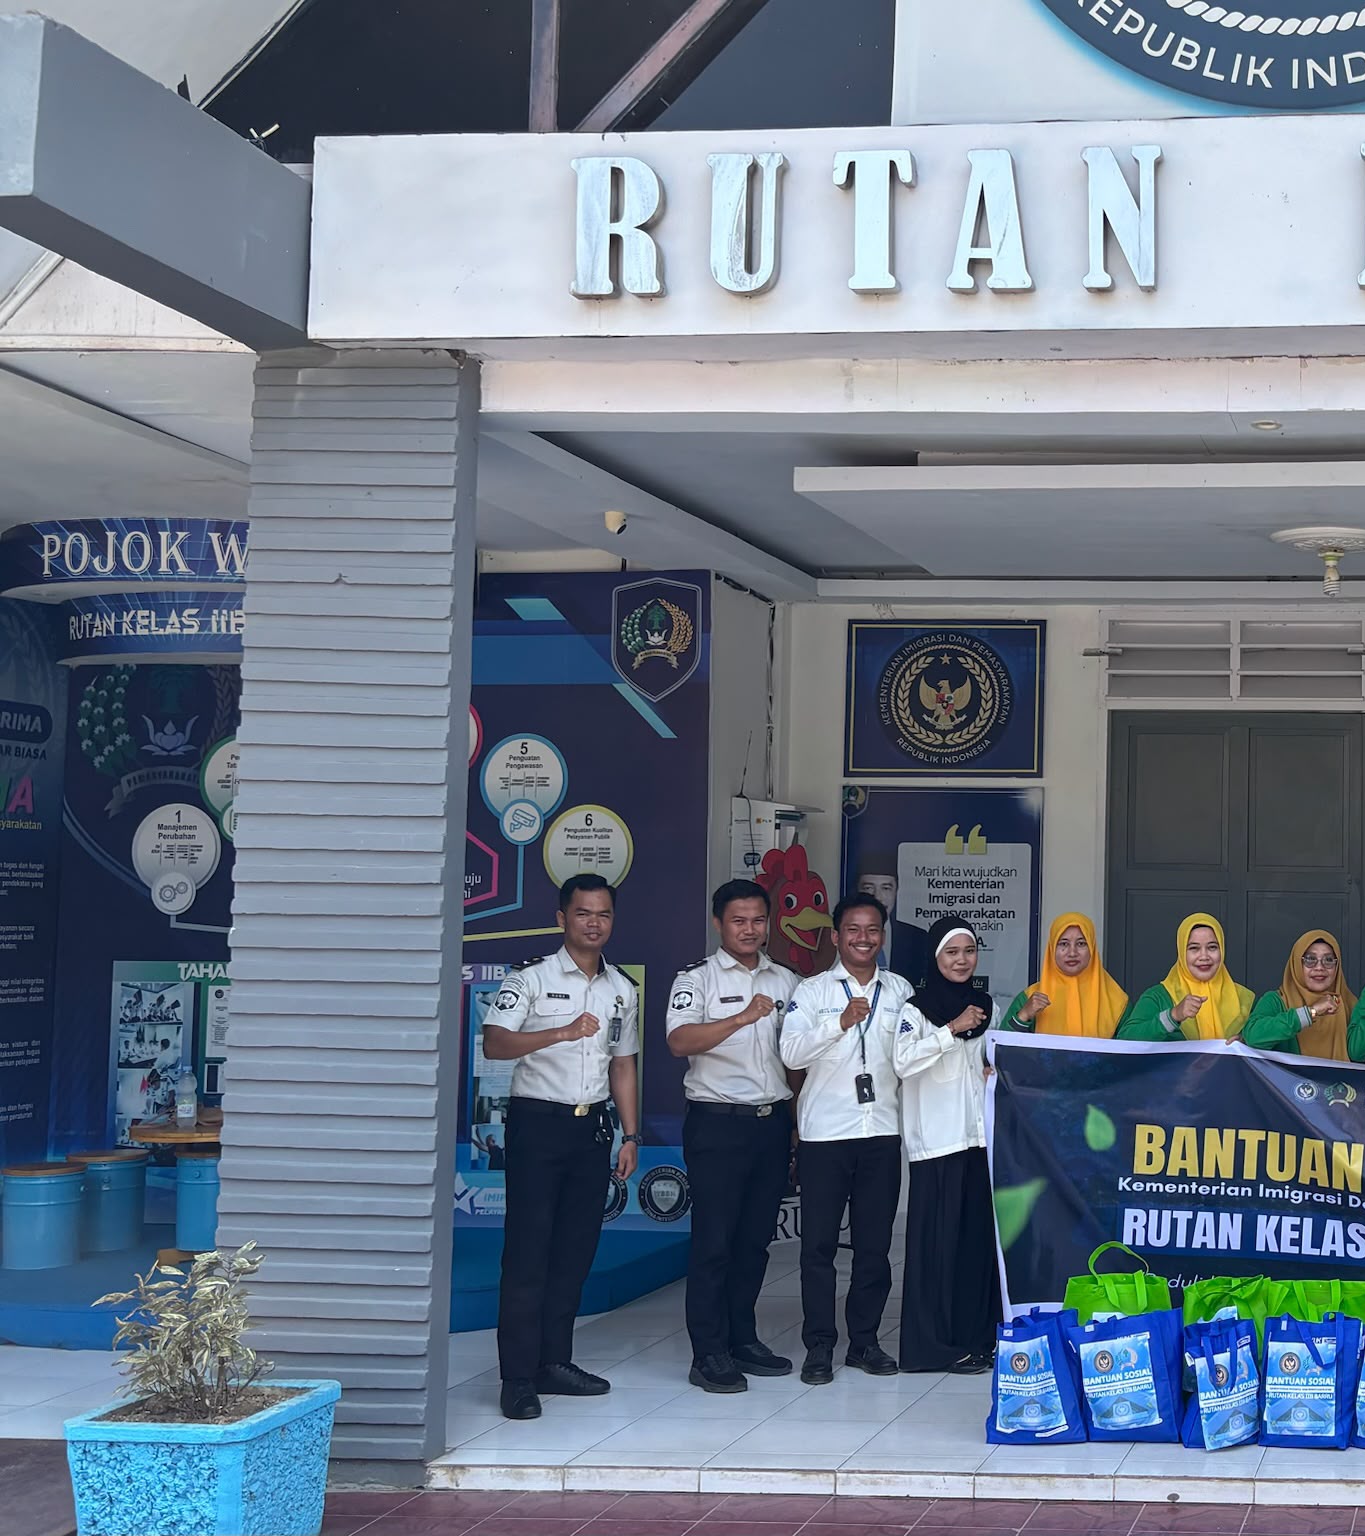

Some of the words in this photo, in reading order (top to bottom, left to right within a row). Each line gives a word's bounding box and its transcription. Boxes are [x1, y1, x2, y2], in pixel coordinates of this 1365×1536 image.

[569, 146, 1165, 300] RUTAN
[41, 531, 195, 578] POJOK
[69, 612, 115, 640] RUTAN
[122, 608, 200, 637] KELAS
[880, 654, 904, 725] KEMENTERIAN
[903, 634, 946, 657] IMIGRASI
[949, 634, 971, 646] DAN
[972, 641, 1011, 725] PEMASYARAKATAN
[14, 746, 47, 760] BIASA
[520, 742, 528, 755] 5
[896, 737, 938, 763] REPUBLIK
[942, 739, 991, 764] INDONESIA
[508, 754, 541, 762] Penguatan
[175, 810, 181, 823] 1
[585, 813, 593, 826] 6
[158, 823, 197, 832] Manajemen
[915, 866, 939, 877] Mari
[942, 866, 961, 877] kita
[963, 866, 1017, 879] wujudkan
[927, 878, 1005, 889] Kementerian
[928, 893, 975, 906] Imigrasi
[978, 893, 1000, 904] dan
[915, 908, 1015, 919] Pemasyarakatan
[482, 966, 506, 981] IIB
[1133, 1124, 1364, 1193] BANTUAN
[1118, 1177, 1252, 1196] Kementerian
[1259, 1184, 1342, 1204] Imigrasi
[1123, 1208, 1242, 1250] RUTAN
[1000, 1374, 1036, 1385] BANTUAN
[1083, 1374, 1122, 1385] BANTUAN
[1124, 1368, 1152, 1380] SOSIAL
[1268, 1377, 1306, 1386] BANTUAN
[1308, 1377, 1335, 1386] SOSIAL
